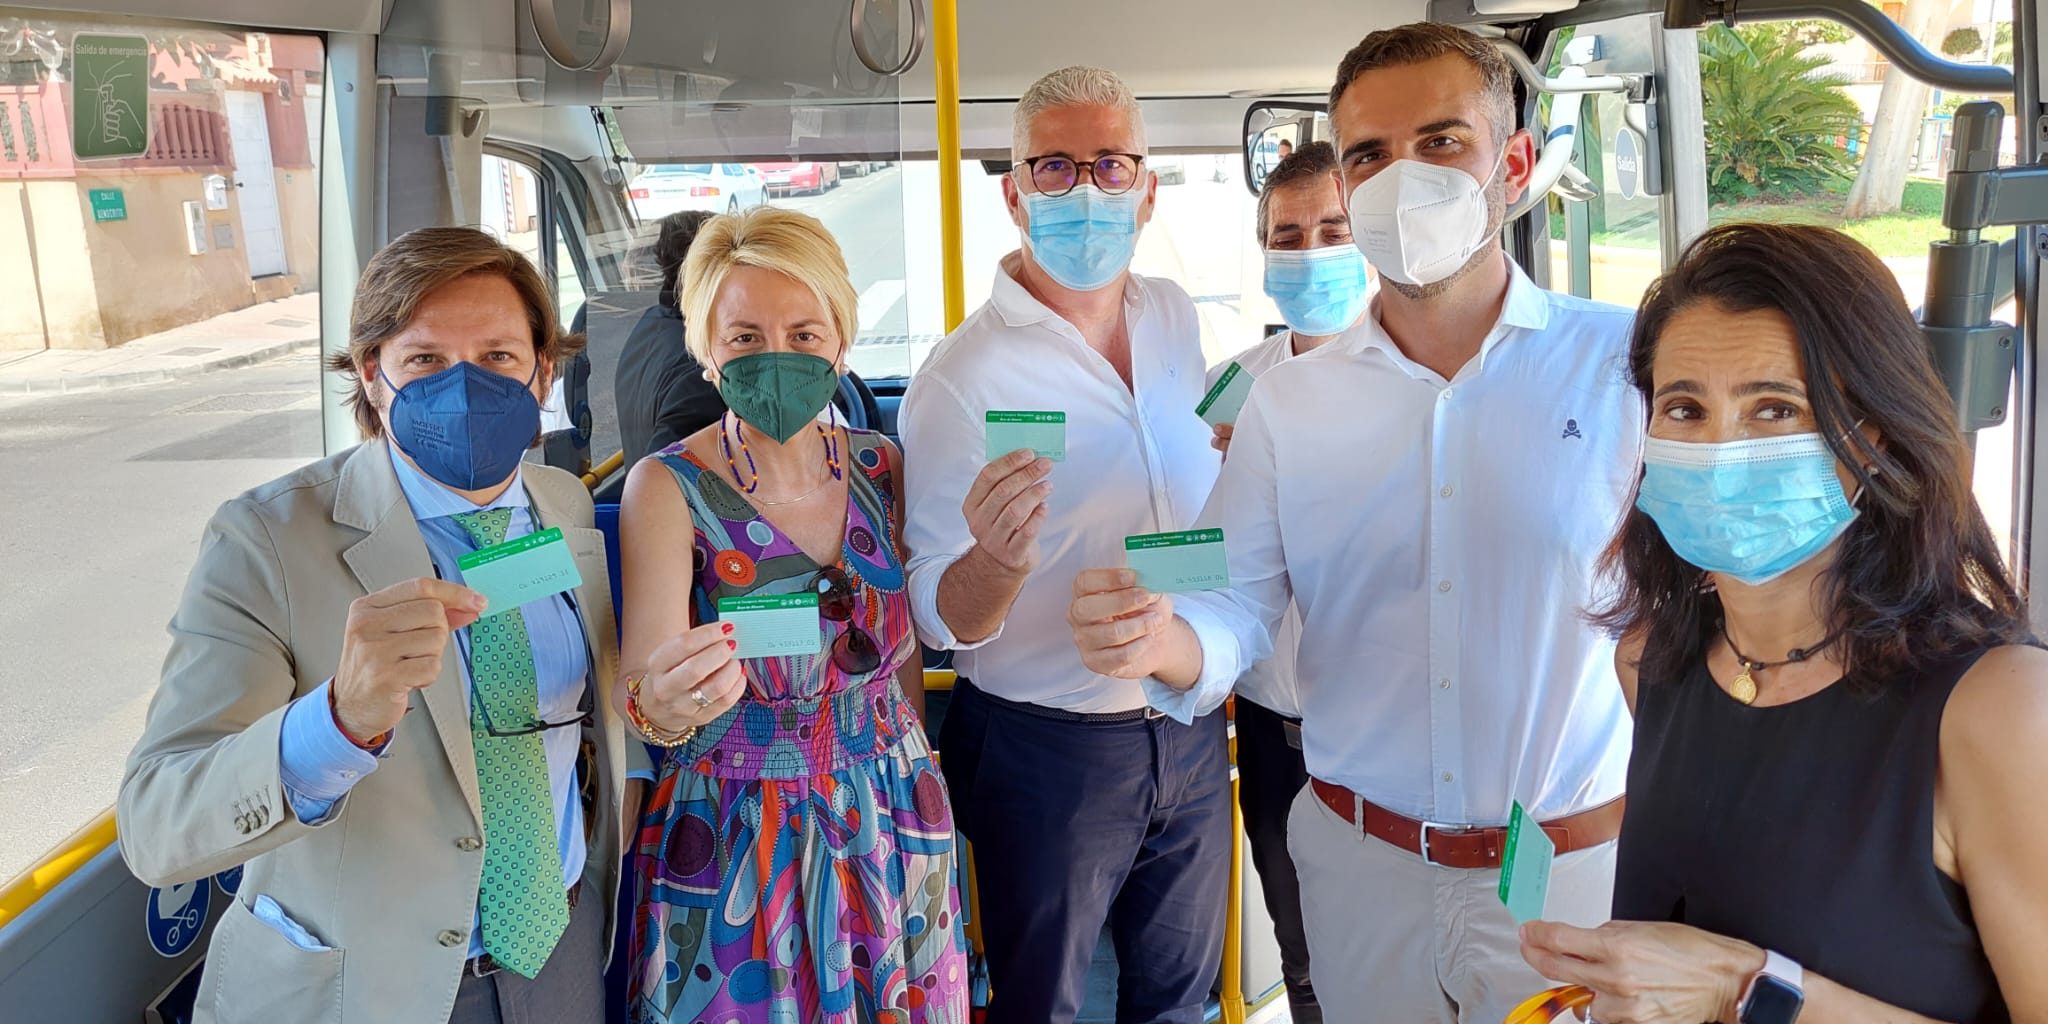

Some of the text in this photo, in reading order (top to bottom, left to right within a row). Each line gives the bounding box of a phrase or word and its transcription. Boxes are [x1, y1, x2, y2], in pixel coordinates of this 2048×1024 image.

[75, 43, 148, 58] Salida de emergencia
[1617, 155, 1636, 172] Salida
[101, 191, 115, 201] CALLE
